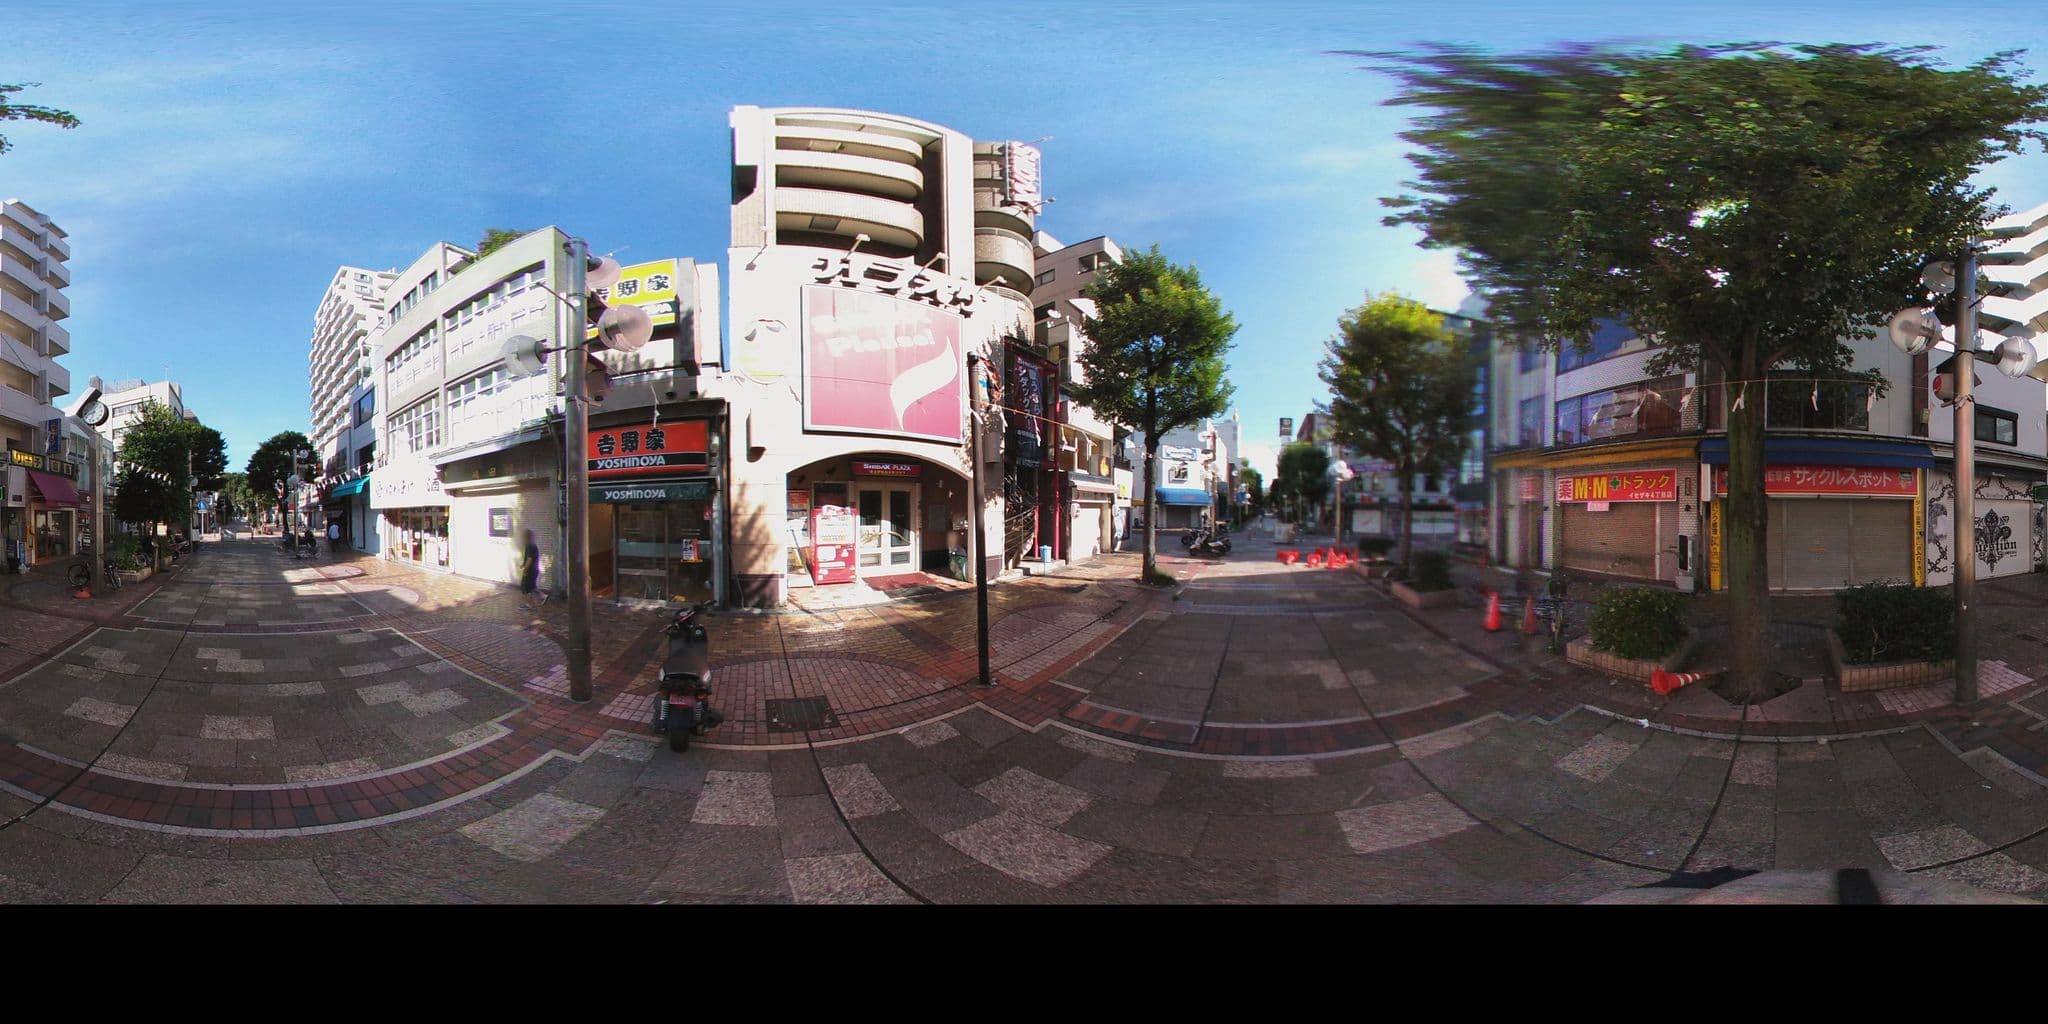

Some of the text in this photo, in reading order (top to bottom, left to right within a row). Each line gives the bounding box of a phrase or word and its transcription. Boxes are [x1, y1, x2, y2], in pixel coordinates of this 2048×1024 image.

[597, 428, 665, 455] 吉野家
[597, 455, 665, 469] YOSHINOYA
[1623, 474, 1670, 490] トラック
[1793, 467, 1892, 488] サイクルスポット
[605, 489, 666, 500] YOSHINOYA
